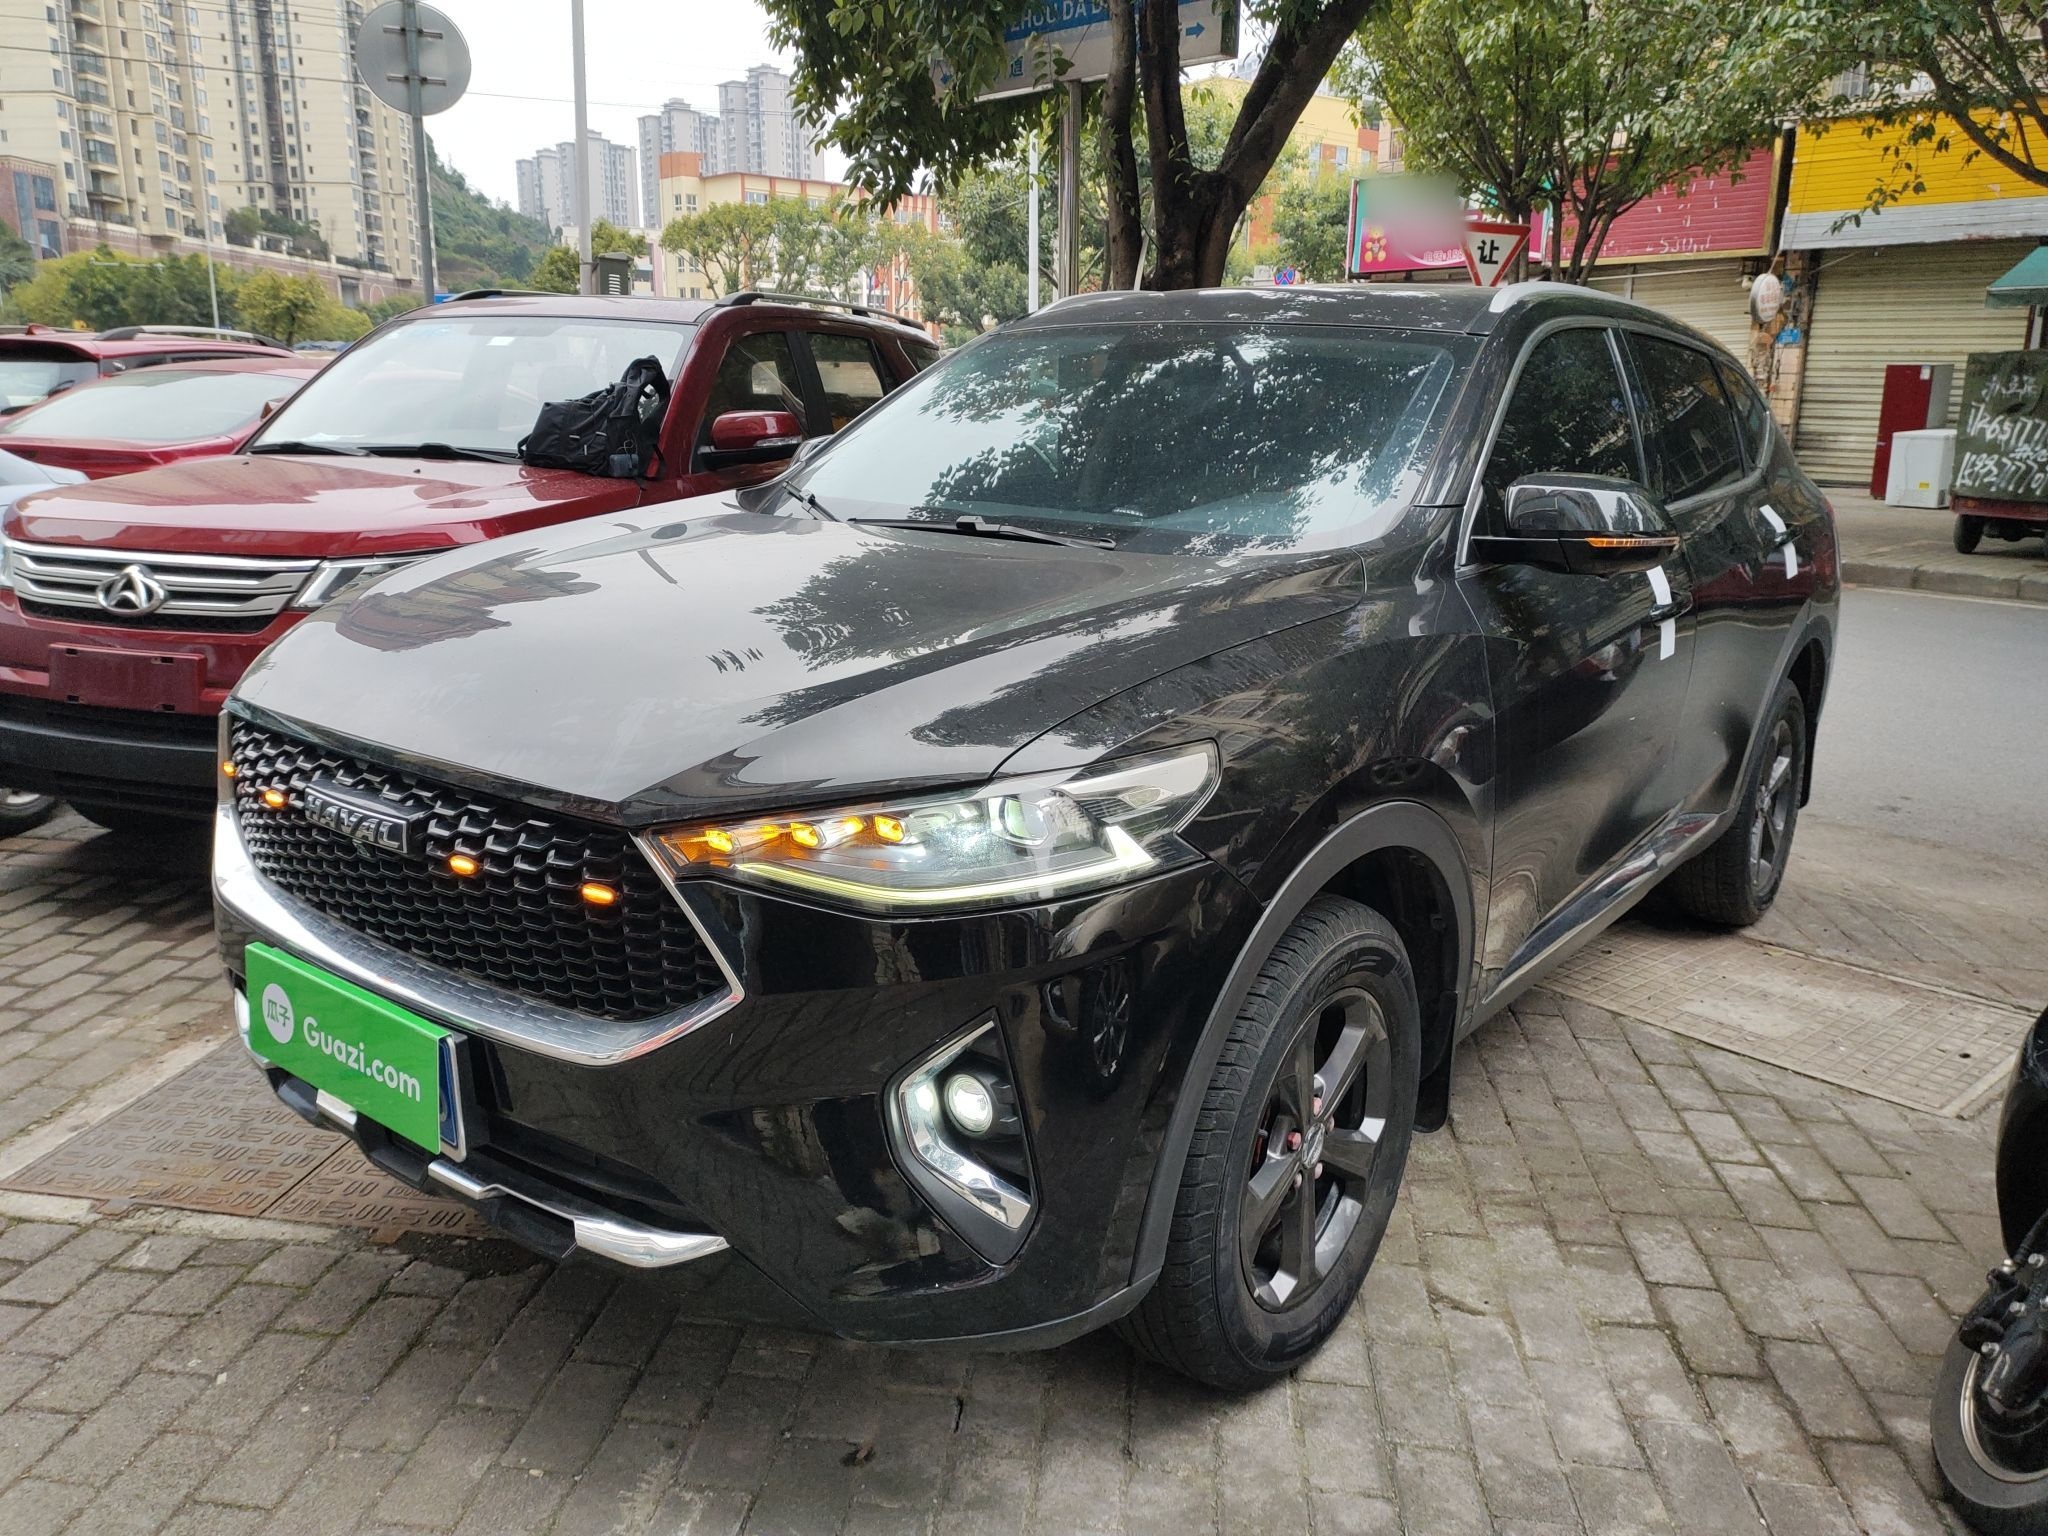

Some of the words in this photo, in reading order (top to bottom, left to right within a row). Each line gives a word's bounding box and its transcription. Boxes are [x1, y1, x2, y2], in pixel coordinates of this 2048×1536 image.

[1010, 3, 1058, 32] HOU
[1477, 239, 1500, 265] 让
[305, 794, 401, 849] HAVAL
[267, 998, 290, 1028] 瓜子
[303, 1016, 421, 1103] Guazi.com
